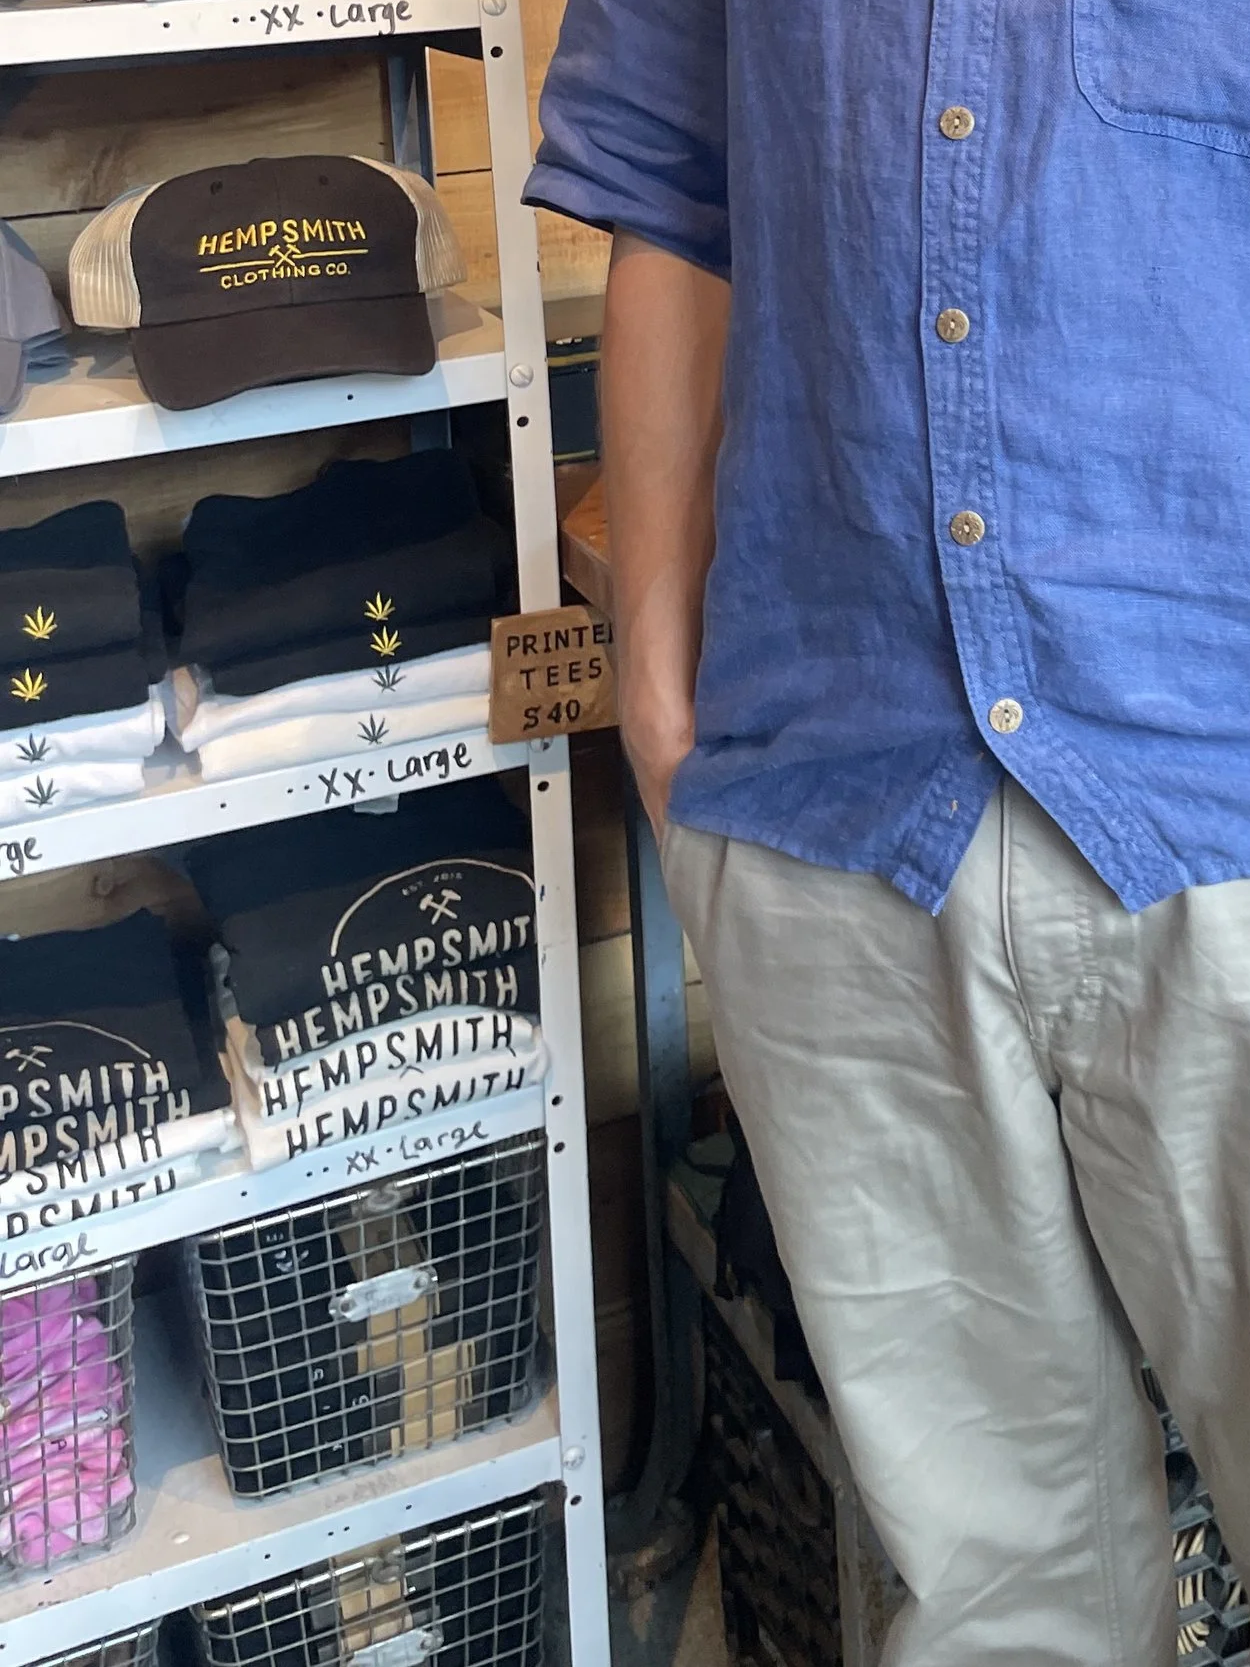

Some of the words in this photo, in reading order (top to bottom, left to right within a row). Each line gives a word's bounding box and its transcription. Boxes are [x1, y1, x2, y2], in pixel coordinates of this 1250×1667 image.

[330, 0, 413, 36] Large
[197, 218, 367, 256] HEMPSMITH
[220, 264, 321, 290] CLOTHING
[520, 657, 603, 690] TEES
[388, 739, 473, 784] Large
[321, 915, 538, 999] HEMPSMIT
[275, 964, 518, 1060] HEMPSMITH
[264, 1014, 513, 1117] HEMPSMITH
[285, 1067, 526, 1160] HEMPSMITH
[399, 1120, 490, 1161] Large
[0, 1232, 98, 1279] Large
